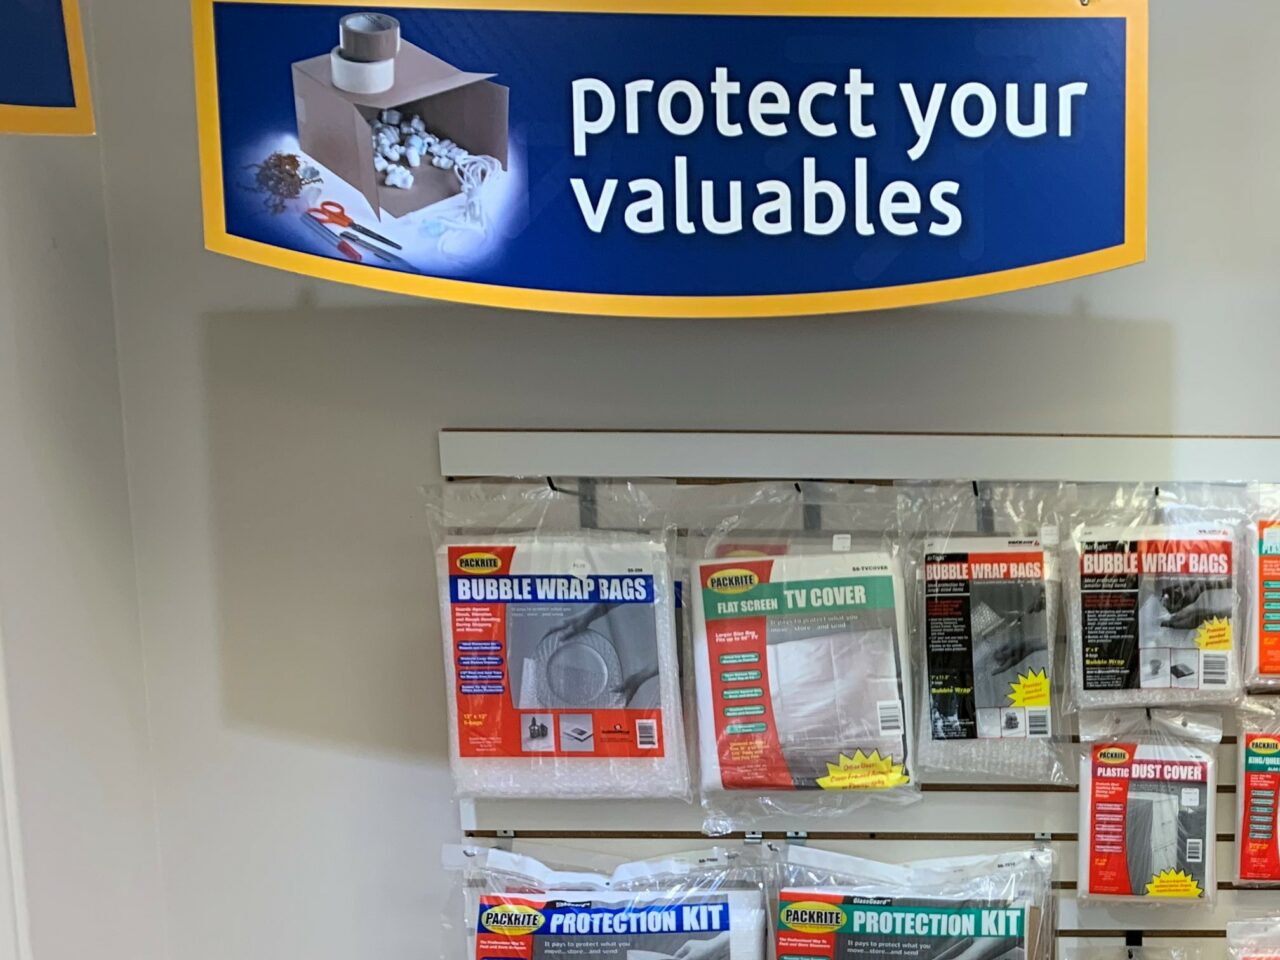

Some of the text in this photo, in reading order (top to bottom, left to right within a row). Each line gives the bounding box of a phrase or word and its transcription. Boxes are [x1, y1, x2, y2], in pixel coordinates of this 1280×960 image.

[571, 66, 1087, 161] protect your
[570, 155, 962, 236] valuables
[460, 558, 498, 568] PACKRITE
[926, 563, 1041, 580] BUBBLE WRAP BAGS
[1083, 554, 1228, 574] BUBBLE WRAP BAGS
[458, 578, 646, 600] BUBBLE WRAP BAGS
[711, 574, 754, 587] PACKRITE
[717, 585, 866, 614] FLAT SCREEN TV COVER
[1251, 742, 1279, 750] PACKRITE
[1097, 764, 1201, 780] PLASTIC DUST COVER
[485, 912, 538, 926] PACKRITE
[551, 904, 723, 934] PROTECTION KIT
[785, 911, 841, 925] PACKRITE
[853, 909, 1021, 935] PROTECTION KIT
